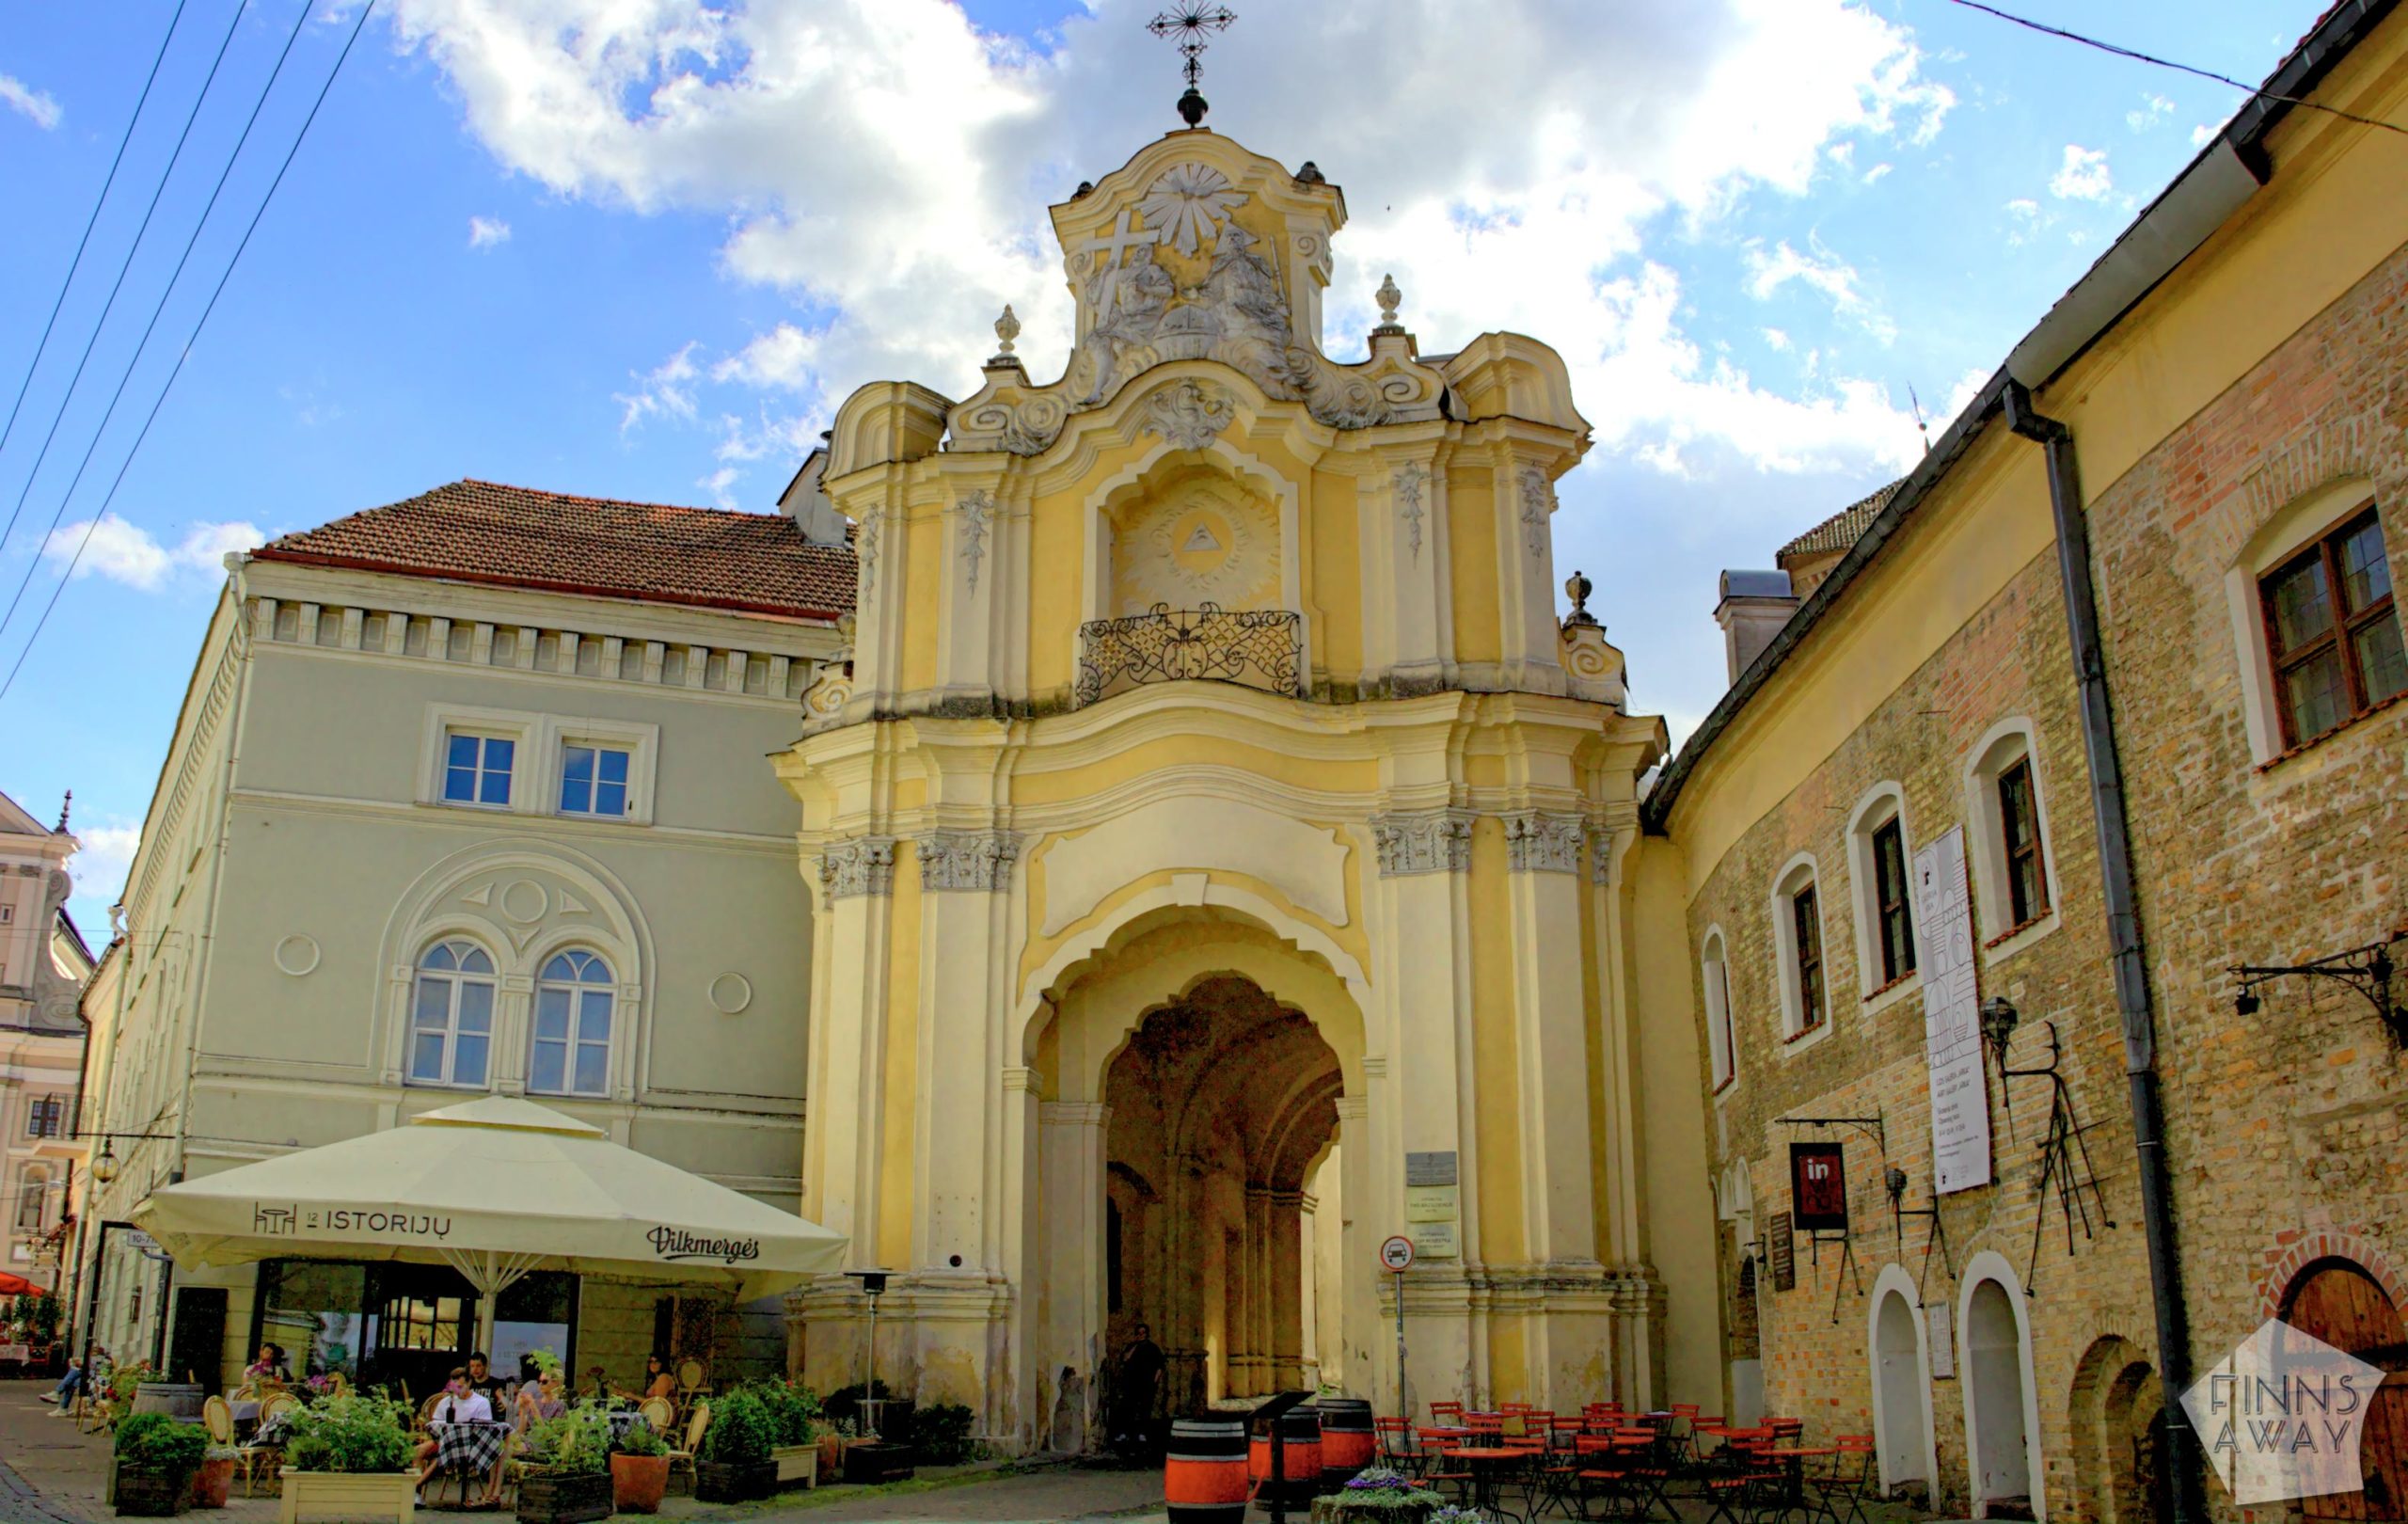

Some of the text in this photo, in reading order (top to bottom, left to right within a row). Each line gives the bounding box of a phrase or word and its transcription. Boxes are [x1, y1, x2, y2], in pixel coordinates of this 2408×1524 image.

[1806, 1158, 1830, 1180] in
[307, 1210, 452, 1240] 12 ISTORIJŲ
[646, 1225, 760, 1264] Vilkmergės
